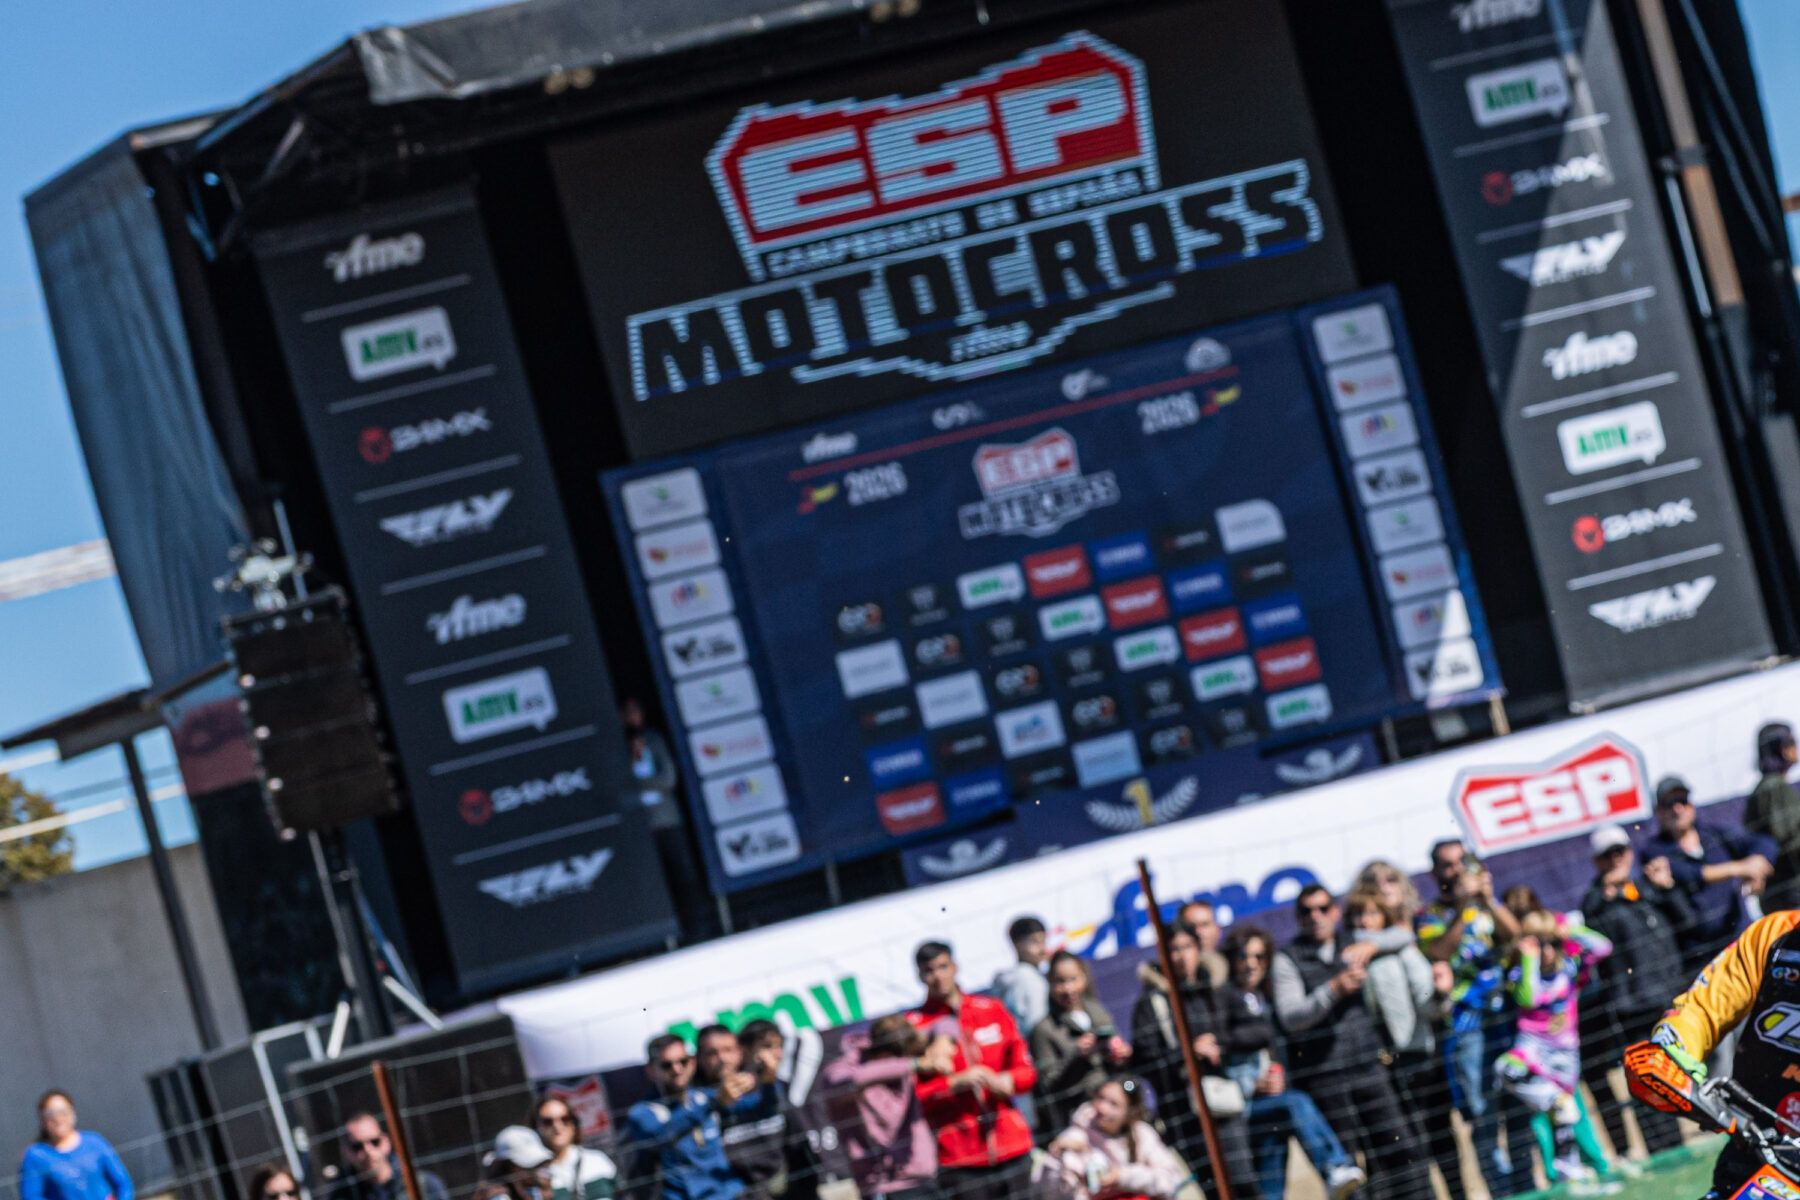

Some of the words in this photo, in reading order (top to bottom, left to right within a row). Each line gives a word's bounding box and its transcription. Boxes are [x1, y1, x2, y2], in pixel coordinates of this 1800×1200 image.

[737, 69, 1124, 232] ESP
[642, 168, 1316, 392] MOTOCROSS
[767, 211, 966, 276] CAMPEONATO
[975, 198, 1017, 230] DE
[1027, 166, 1142, 218] ESPAÑA
[1466, 758, 1635, 840] ESP
